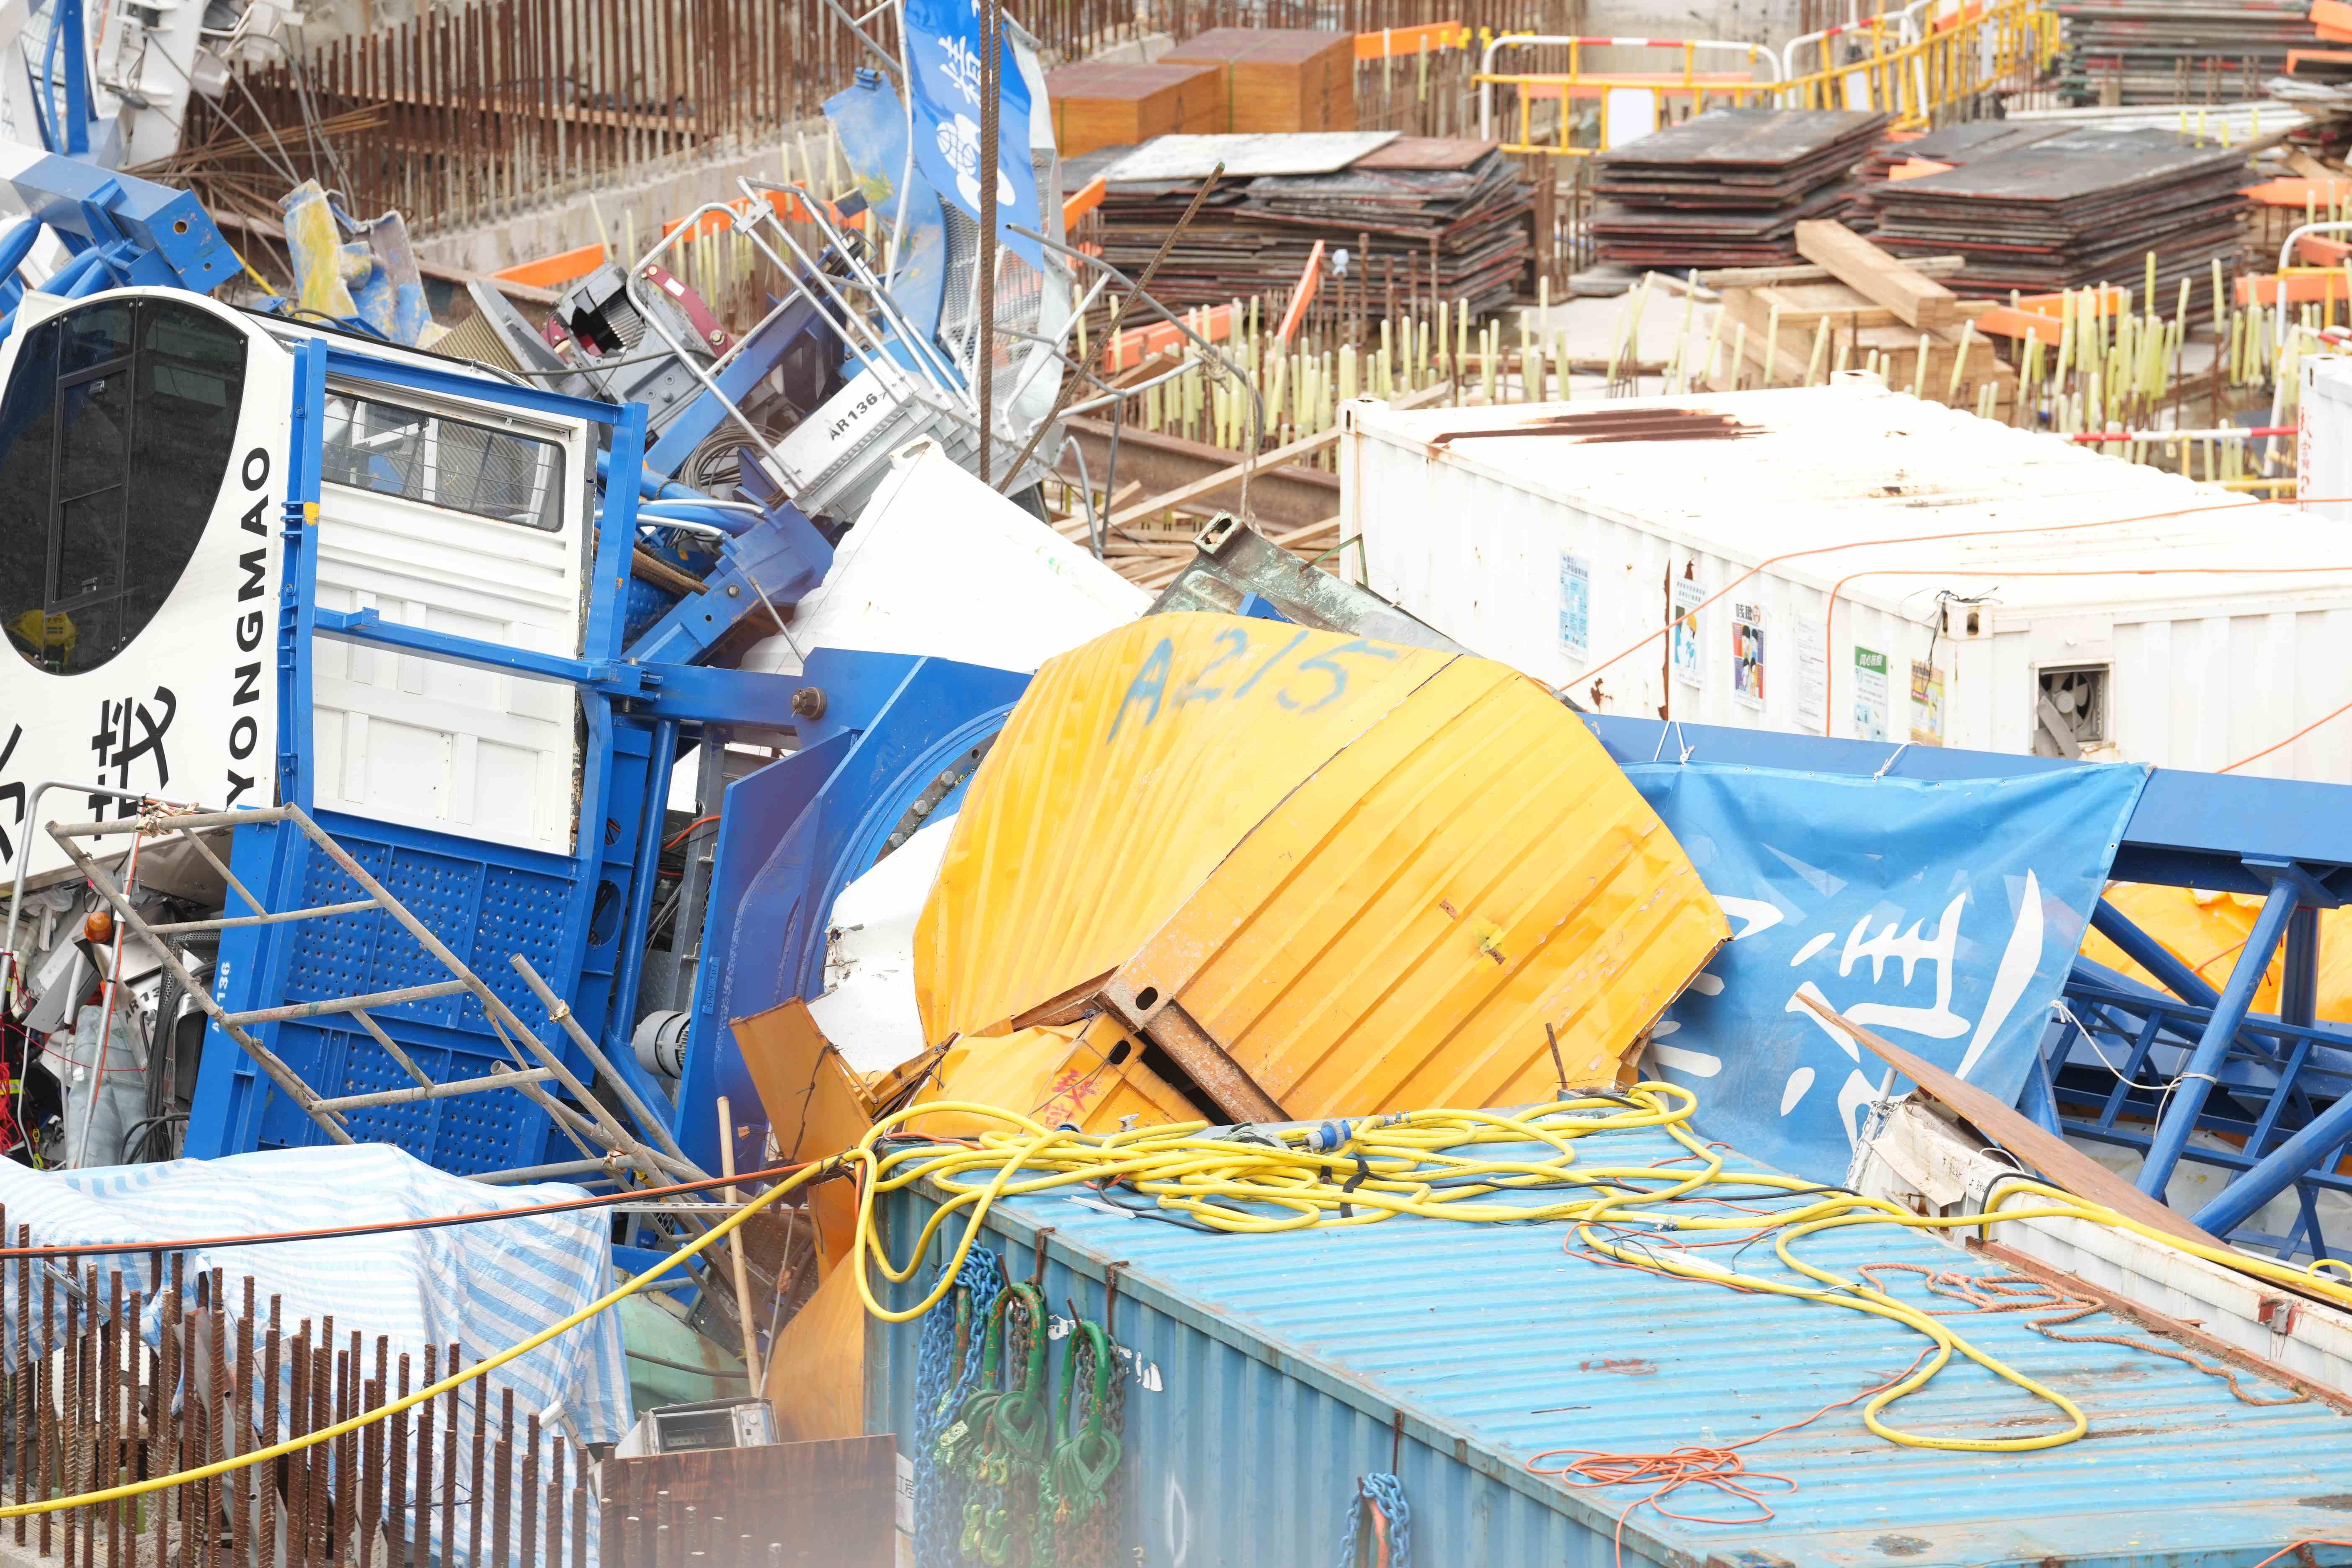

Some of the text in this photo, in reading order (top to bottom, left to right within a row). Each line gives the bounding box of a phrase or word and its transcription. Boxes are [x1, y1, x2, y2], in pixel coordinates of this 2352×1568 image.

[829, 391, 878, 441] AR136
[227, 448, 270, 807] YONGMAO
[211, 962, 230, 1032] A136
